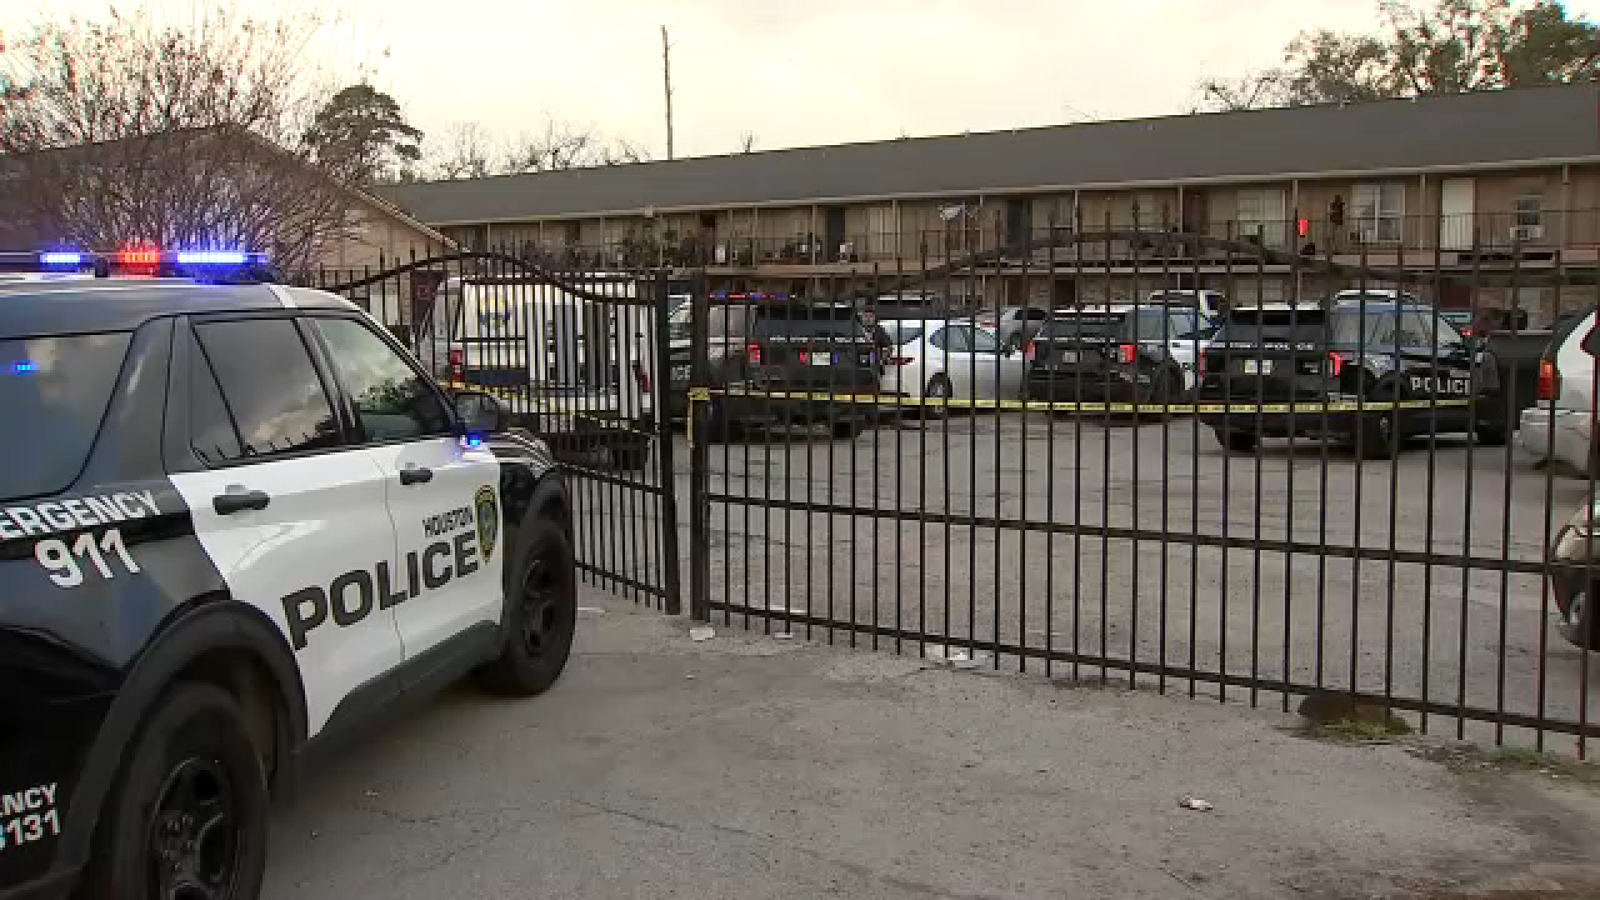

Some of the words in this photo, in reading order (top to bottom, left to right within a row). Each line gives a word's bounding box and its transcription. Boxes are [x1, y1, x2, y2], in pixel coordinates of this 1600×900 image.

[34, 528, 141, 588] 911
[280, 530, 478, 651] POLICE
[0, 782, 58, 817] NCY
